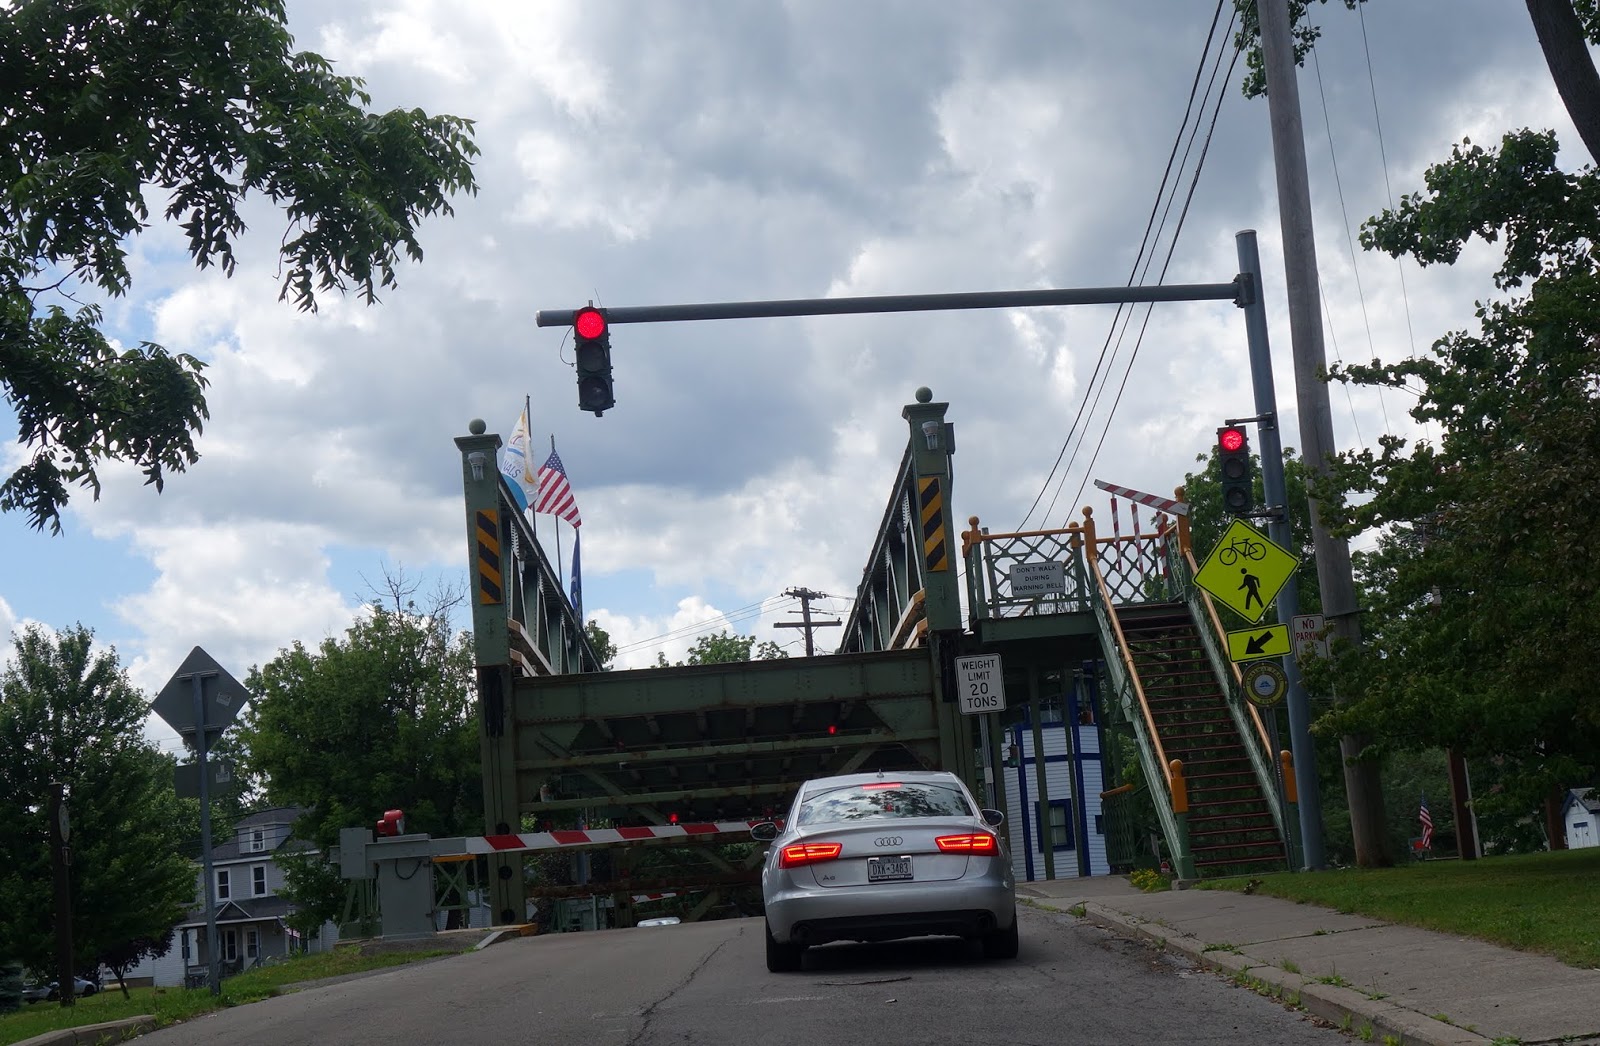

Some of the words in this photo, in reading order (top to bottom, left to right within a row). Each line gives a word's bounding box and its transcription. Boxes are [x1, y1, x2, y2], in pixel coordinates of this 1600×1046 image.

[1024, 574, 1050, 582] DURING
[1302, 619, 1315, 629] NO
[961, 659, 995, 670] WEIGHT
[967, 671, 991, 681] LIMIT
[970, 682, 989, 696] 20
[966, 695, 998, 708] TONS
